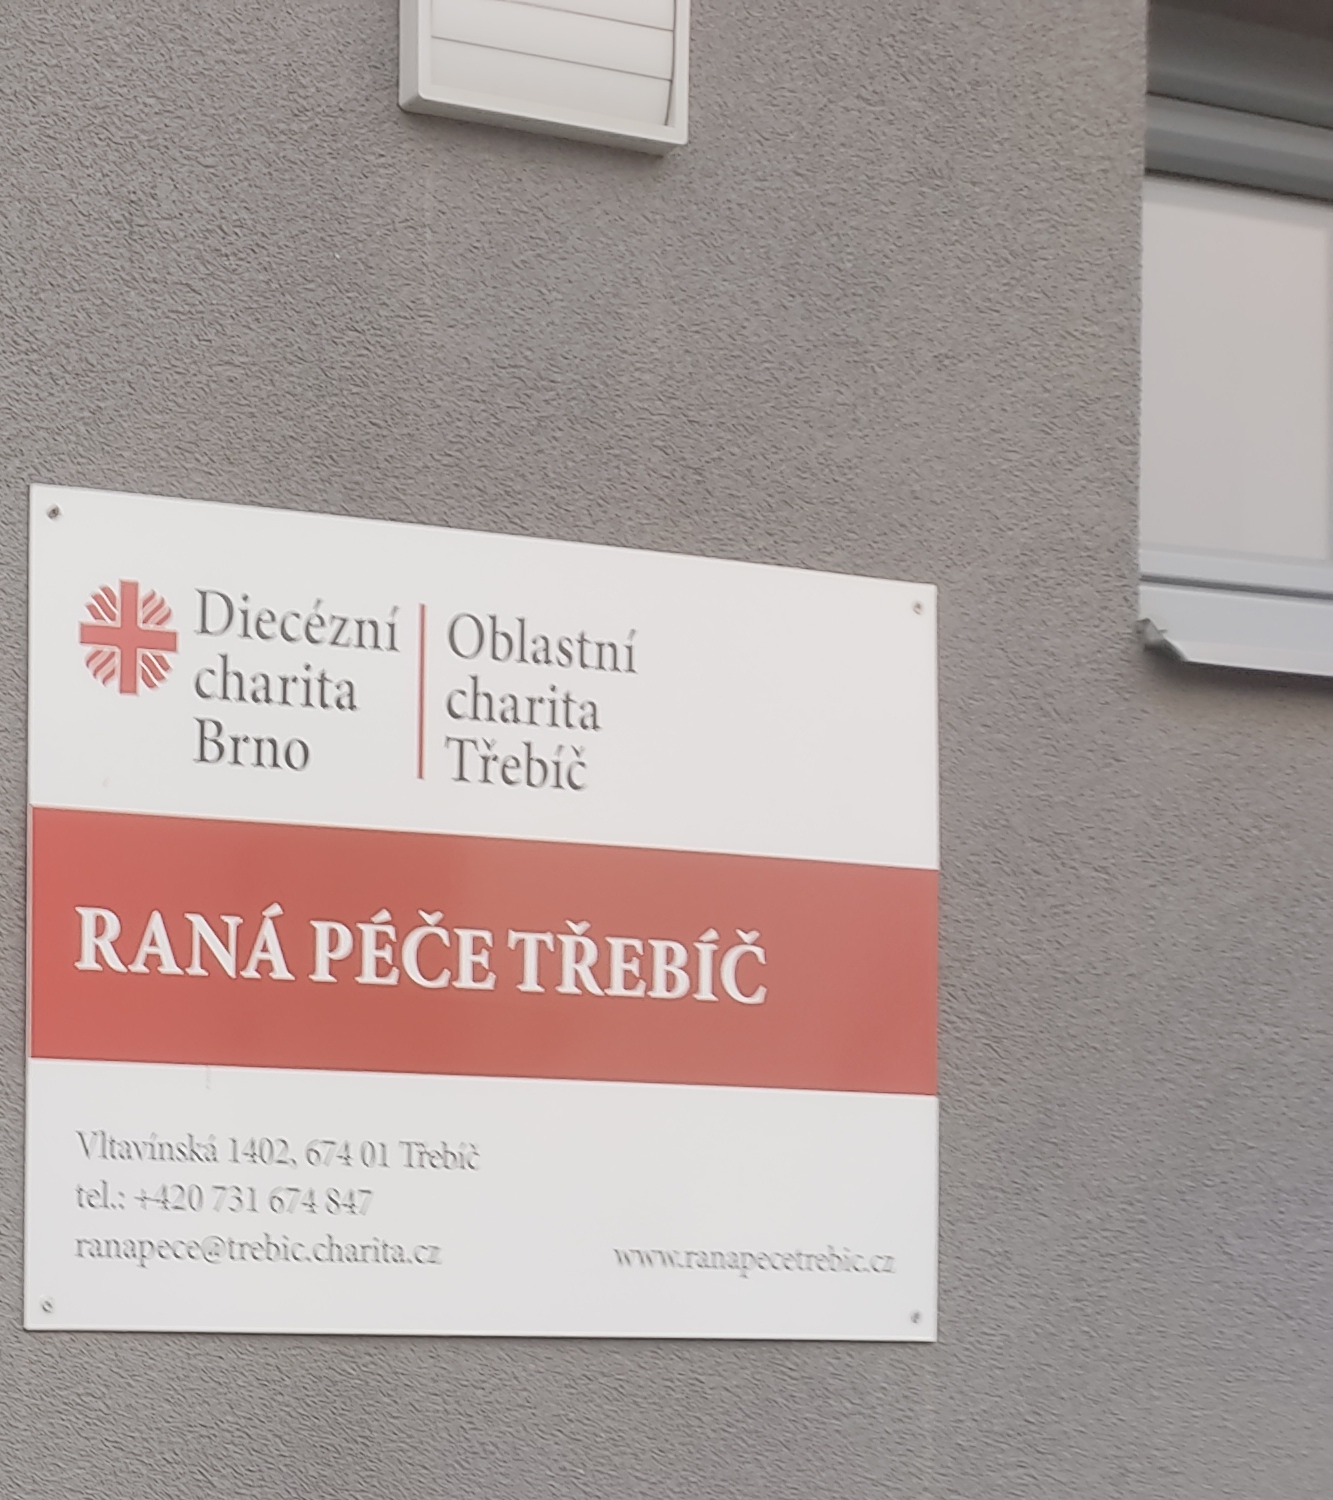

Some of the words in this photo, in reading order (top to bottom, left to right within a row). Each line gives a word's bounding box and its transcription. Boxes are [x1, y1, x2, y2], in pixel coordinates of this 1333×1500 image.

[194, 588, 400, 654] Diecézní
[447, 612, 638, 675] Oblastní
[193, 654, 358, 713] charita
[445, 675, 602, 732] charita
[193, 718, 311, 772] Brno
[444, 735, 587, 792] Třebíč
[74, 902, 295, 983] RANÁ
[309, 909, 495, 993] PÉČE
[507, 919, 769, 1002] TŘEBÍČ
[76, 1129, 218, 1166] Vltavínská
[228, 1136, 298, 1170] 1402,
[306, 1138, 353, 1169] 674
[359, 1140, 391, 1169] 01
[399, 1140, 480, 1173] Třebíč
[74, 1180, 125, 1211] tel.:
[134, 1186, 203, 1215] +420
[212, 1186, 258, 1216] 731
[268, 1188, 318, 1217] 674
[325, 1188, 374, 1218] 847
[74, 1231, 441, 1268] ranapece@trebic.charita.cz
[614, 1241, 895, 1277] www.ranapecetrebic.cz
